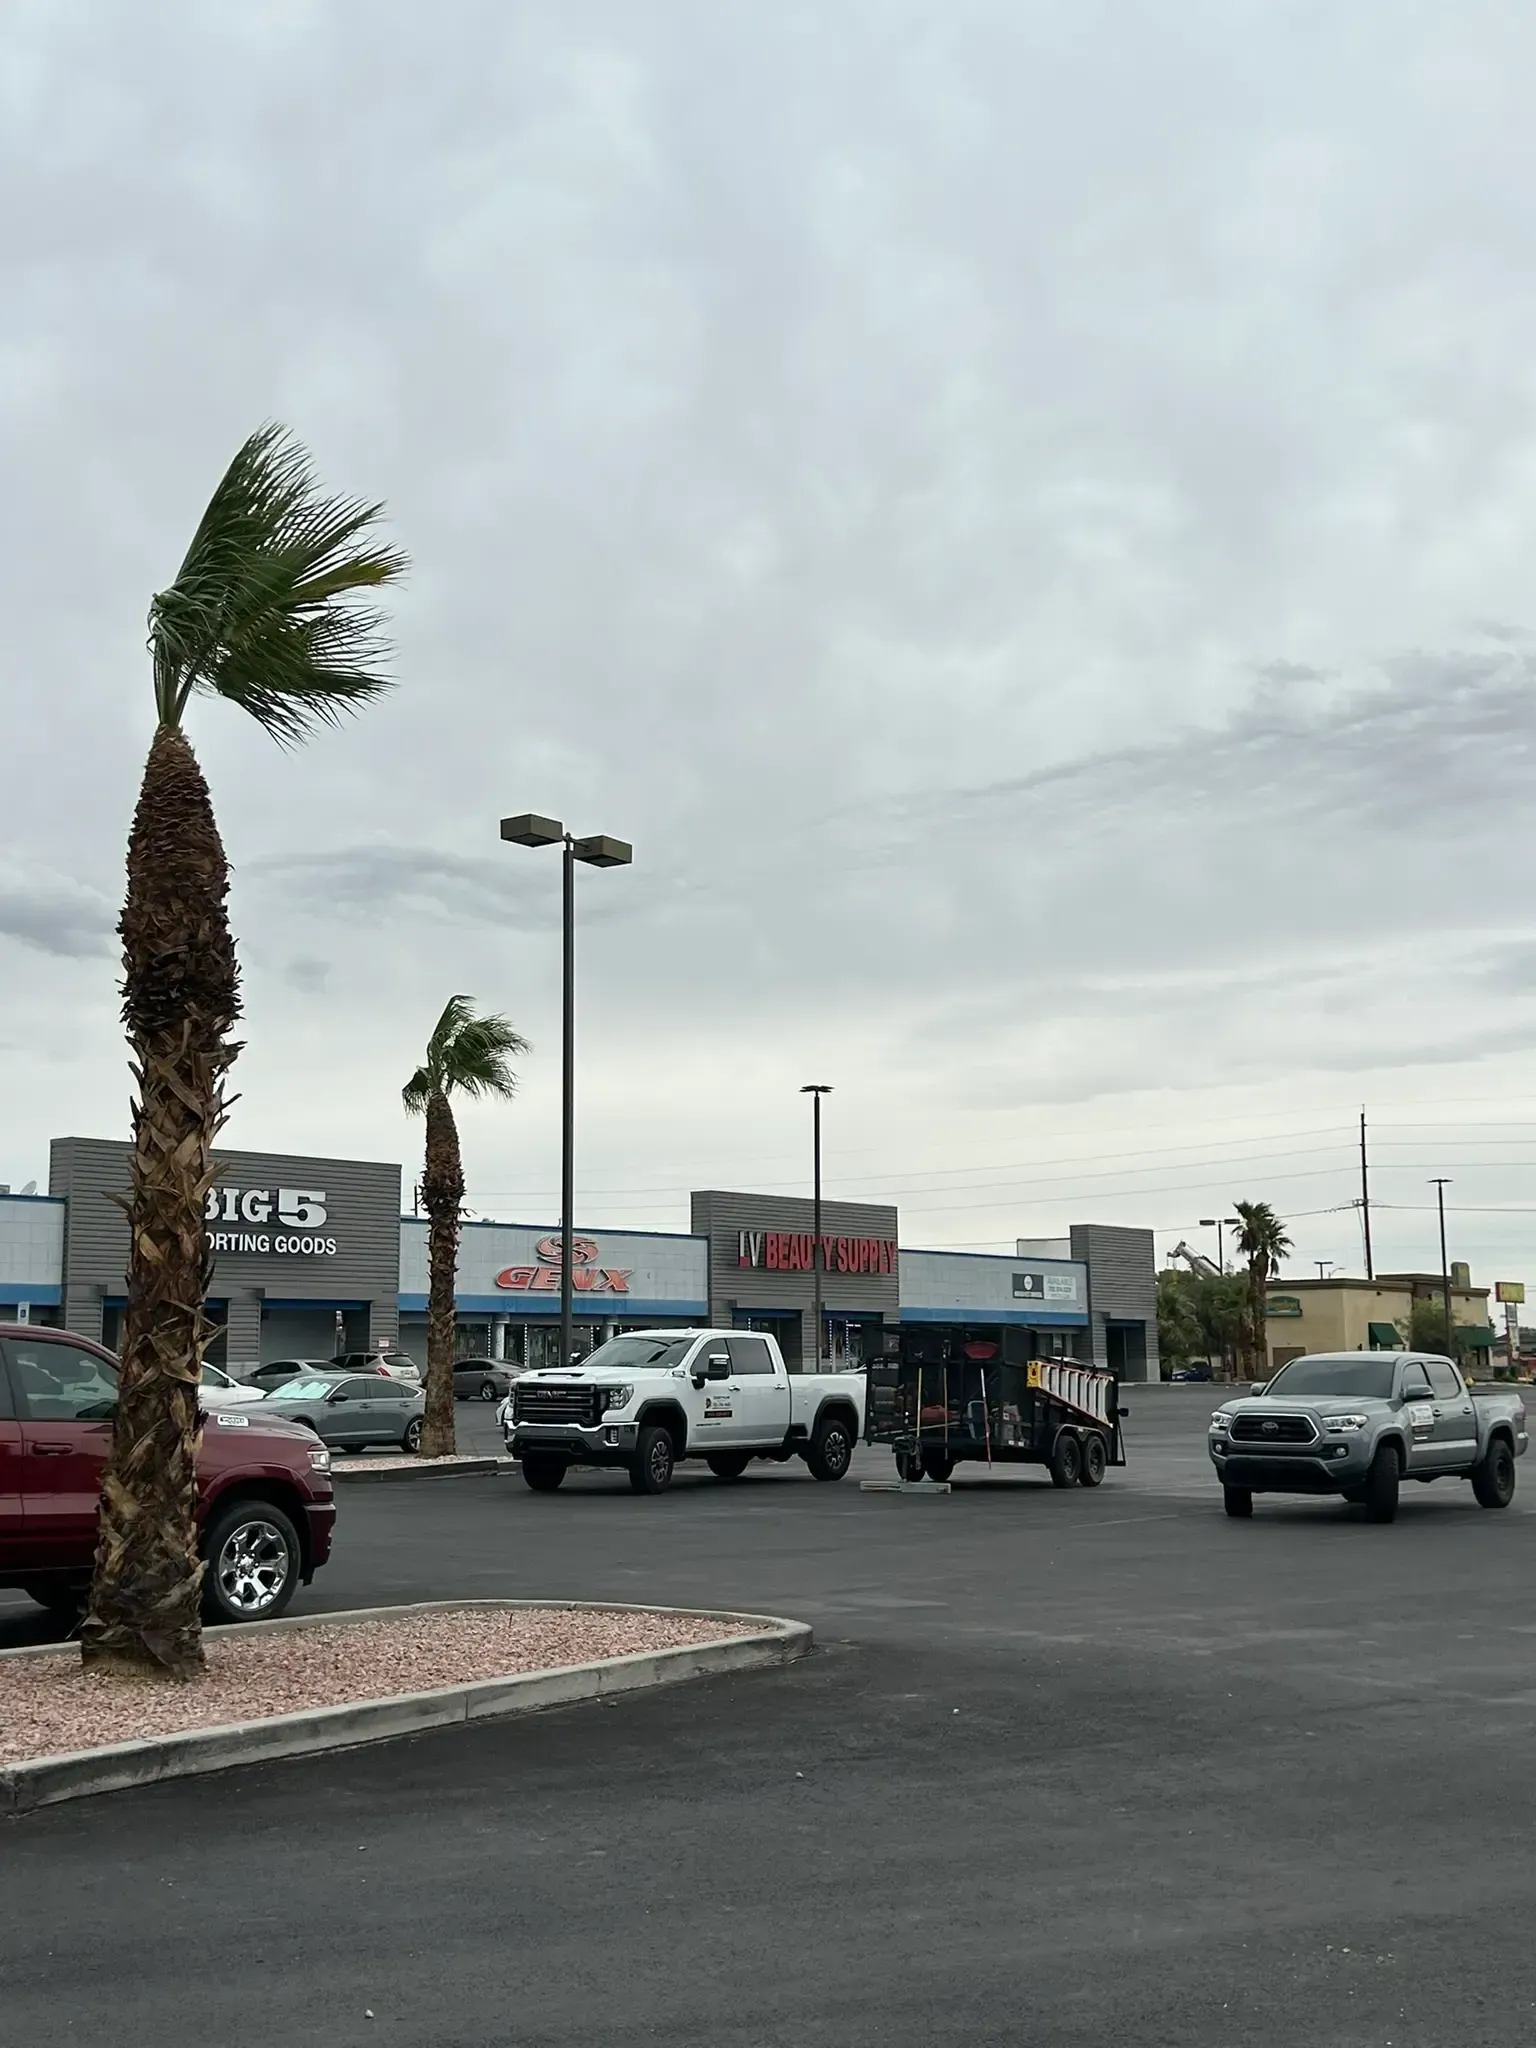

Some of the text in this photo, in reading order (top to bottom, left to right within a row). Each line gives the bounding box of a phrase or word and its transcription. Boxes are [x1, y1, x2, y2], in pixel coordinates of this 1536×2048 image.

[278, 1188, 327, 1229] 5
[205, 1231, 337, 1255] ORTING GOODS
[739, 1231, 896, 1274] LV BEAUY SUPPLY
